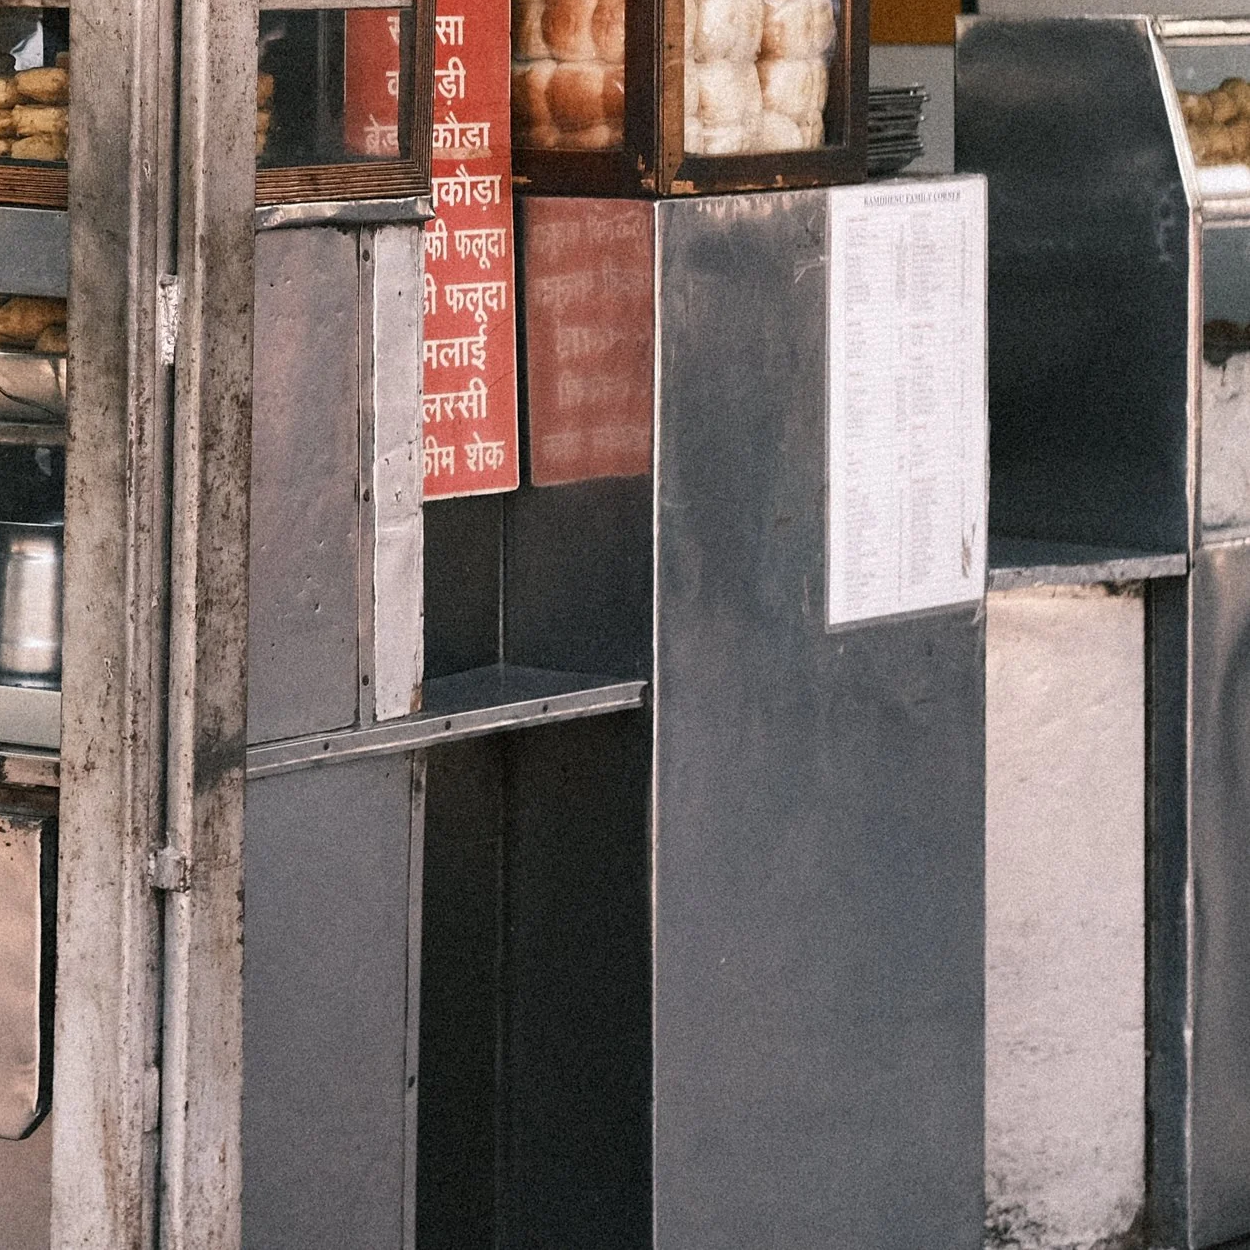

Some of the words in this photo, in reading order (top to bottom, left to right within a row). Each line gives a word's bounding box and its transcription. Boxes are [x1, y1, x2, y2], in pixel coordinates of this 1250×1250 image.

[454, 228, 507, 270] फलूदा
[444, 281, 507, 323] फलूदा
[464, 431, 506, 472] शेक
